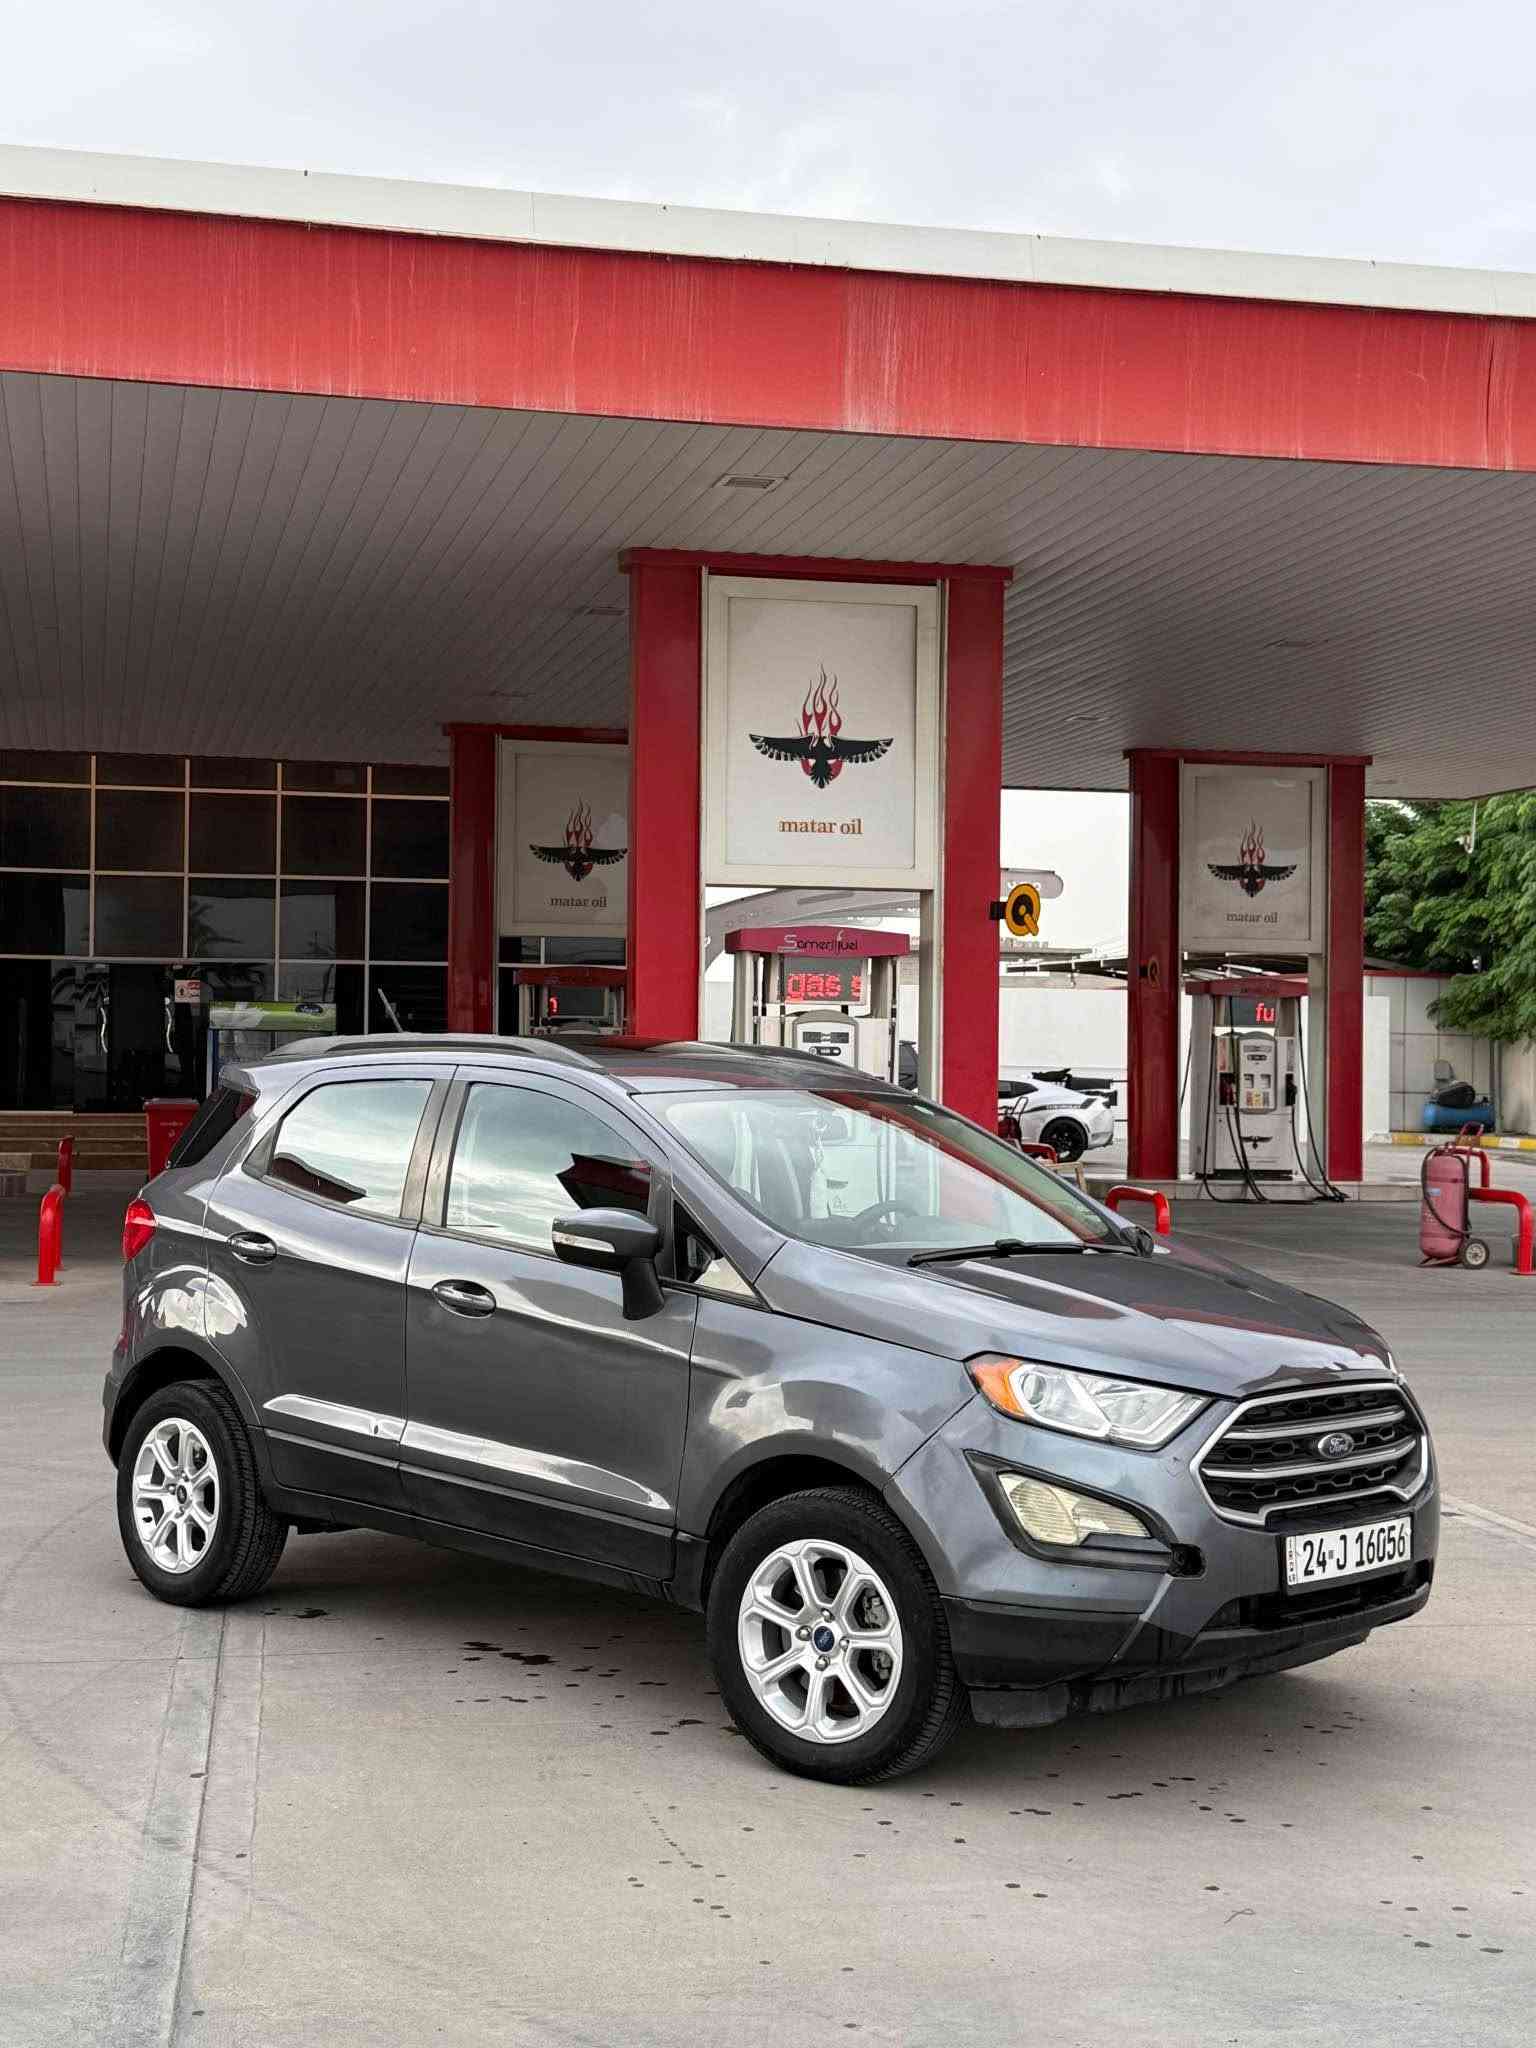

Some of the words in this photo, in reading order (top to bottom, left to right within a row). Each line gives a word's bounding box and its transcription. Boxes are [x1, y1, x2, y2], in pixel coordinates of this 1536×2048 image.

[779, 818, 836, 833] matar
[840, 817, 864, 834] oil
[550, 897, 590, 907] matar
[591, 895, 607, 908] oil
[1226, 911, 1261, 923] matar
[1264, 911, 1279, 924] oil
[786, 973, 842, 1001] gas
[1303, 1537, 1328, 1577] 24
[1336, 1534, 1348, 1570] J
[1355, 1523, 1406, 1568] 16056
